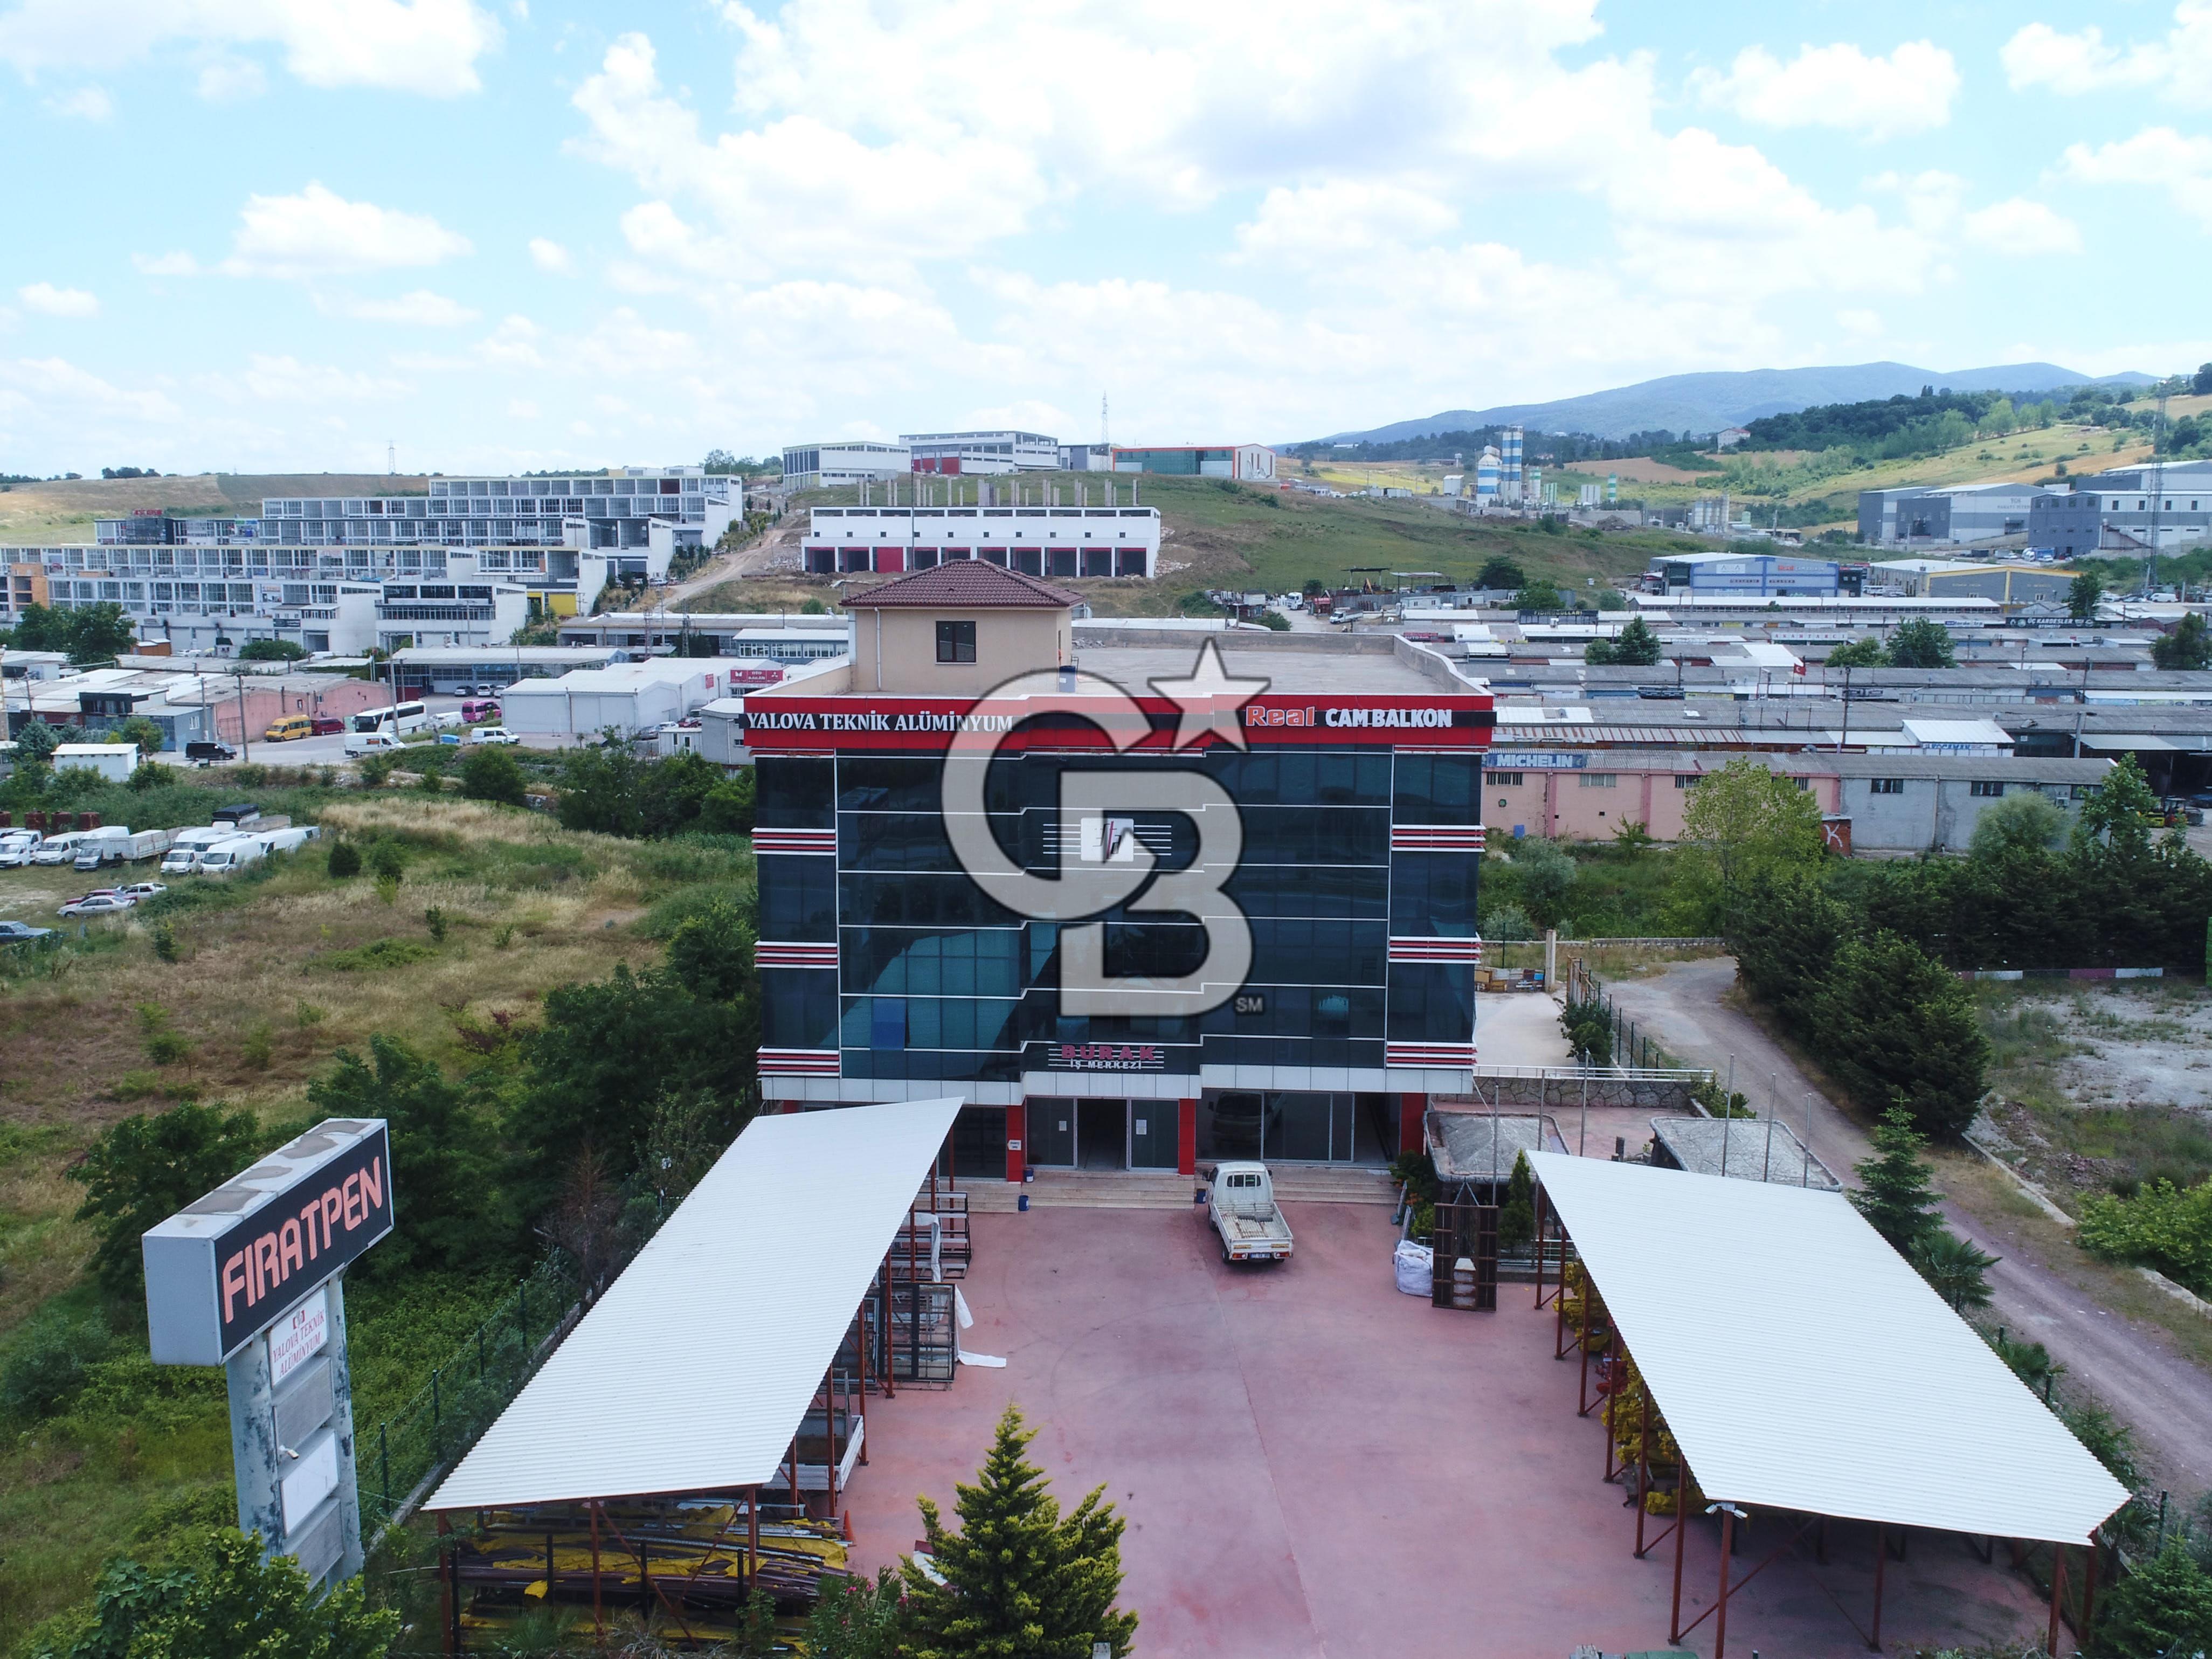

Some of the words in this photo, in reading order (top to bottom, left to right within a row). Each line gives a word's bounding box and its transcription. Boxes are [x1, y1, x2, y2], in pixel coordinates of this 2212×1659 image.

[746, 713, 814, 730] YALOVA
[819, 710, 889, 731] TEKNİK
[894, 710, 1013, 732] ALÜMİNYUM
[1246, 706, 1316, 727] Real
[1497, 755, 1573, 768] MICHELIN
[1061, 1045, 1156, 1060] BURAK
[1070, 1058, 1081, 1070] İŞ
[1088, 1060, 1142, 1070] MERKEZİ
[222, 1156, 383, 1324] FIRATPEN
[273, 1332, 299, 1363] YALOVA
[300, 1309, 324, 1340] TEKNİK
[279, 1331, 321, 1378] ALÜMİNYUM
